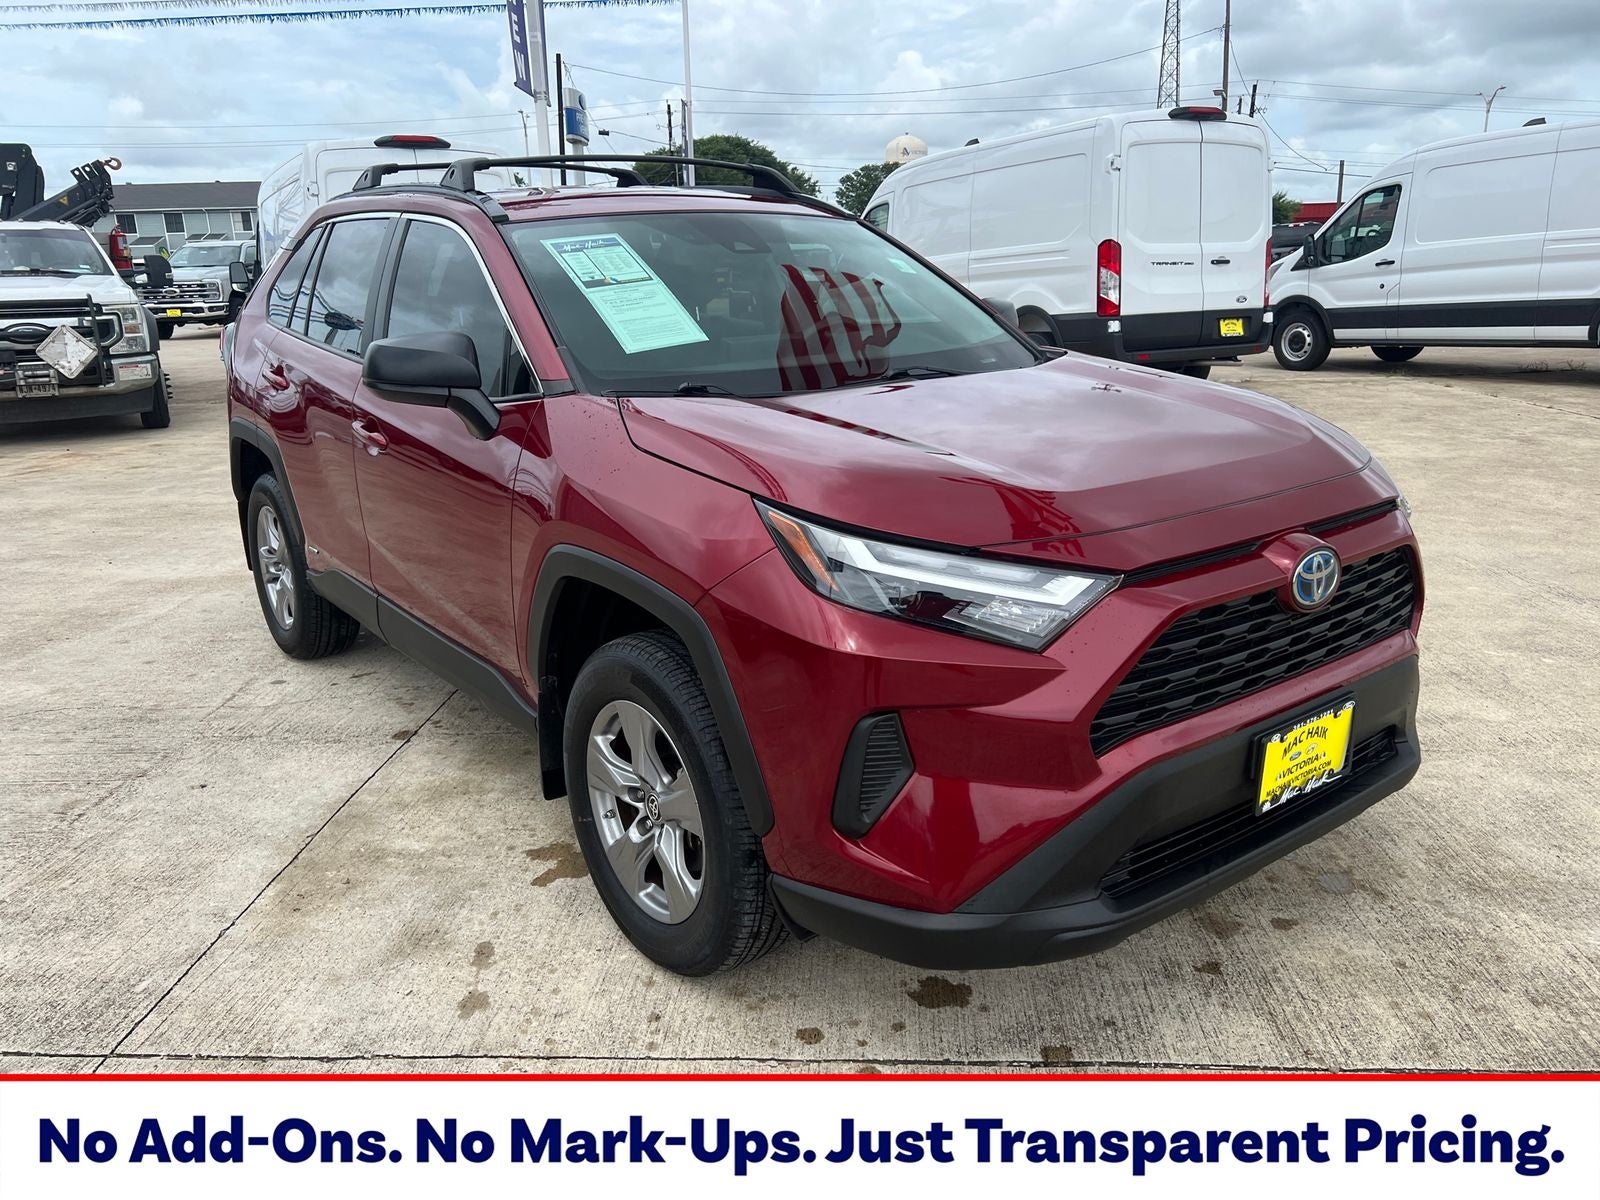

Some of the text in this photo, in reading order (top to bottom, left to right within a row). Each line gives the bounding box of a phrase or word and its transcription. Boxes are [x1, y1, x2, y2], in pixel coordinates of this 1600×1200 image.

[1281, 730, 1306, 760] MAC
[1306, 725, 1329, 740] HAIK
[1281, 753, 1319, 779] VICTORIA
[1280, 769, 1336, 805] Mac Haik
